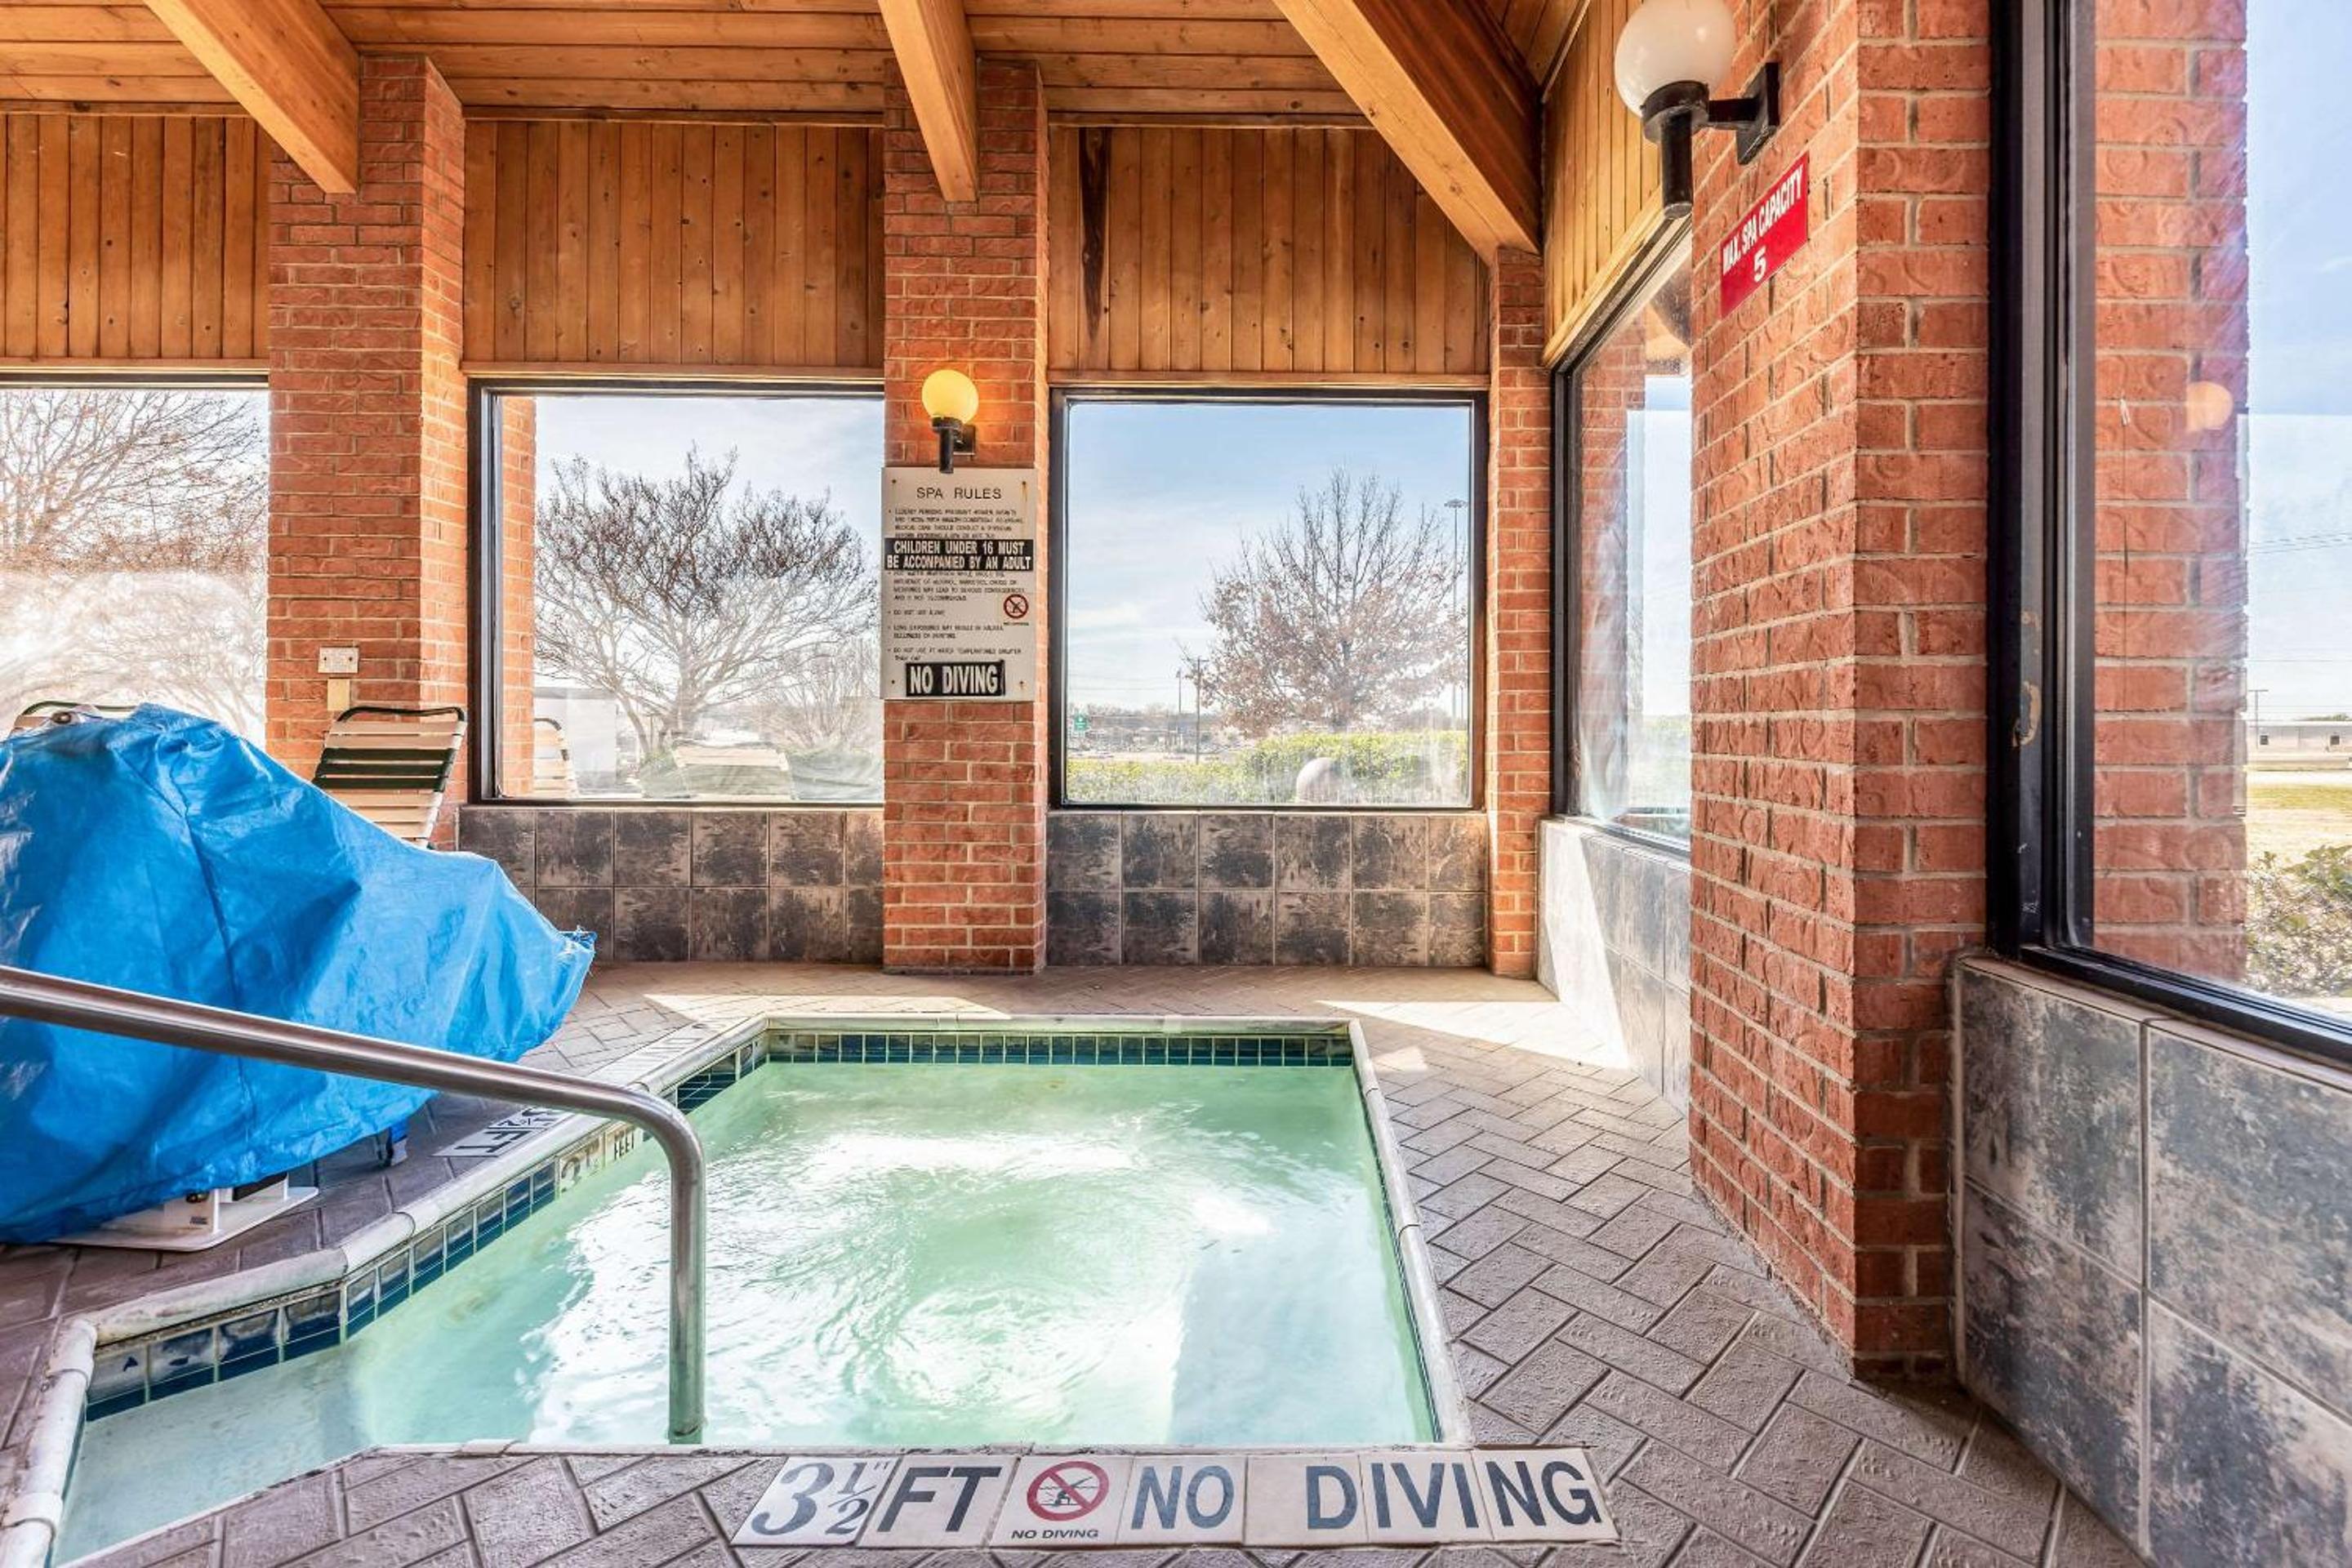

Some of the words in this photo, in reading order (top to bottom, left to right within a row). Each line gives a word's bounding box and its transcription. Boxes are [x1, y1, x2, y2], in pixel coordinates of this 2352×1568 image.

[1742, 215, 1757, 255] SPA
[1758, 163, 1804, 237] CAPACITY
[1753, 246, 1766, 283] 5
[916, 488, 943, 499] SPA
[954, 488, 1001, 499] RULES
[887, 555, 899, 568] BE
[903, 555, 965, 569] ACCOMPANIED
[969, 556, 982, 569] BY
[986, 556, 999, 569] AN
[1003, 556, 1031, 569] ADULT
[893, 540, 940, 554] CHILDREN
[945, 541, 978, 555] UNDER
[982, 541, 993, 555] 16
[998, 541, 1024, 555] MUST
[910, 666, 933, 693] NO
[942, 665, 998, 694] DIVING
[876, 1467, 1003, 1532] FT
[1130, 1464, 1235, 1530] NO
[1307, 1460, 1601, 1530] DIVING
[1011, 1530, 1037, 1539] NO
[1042, 1529, 1098, 1539] DIVING
